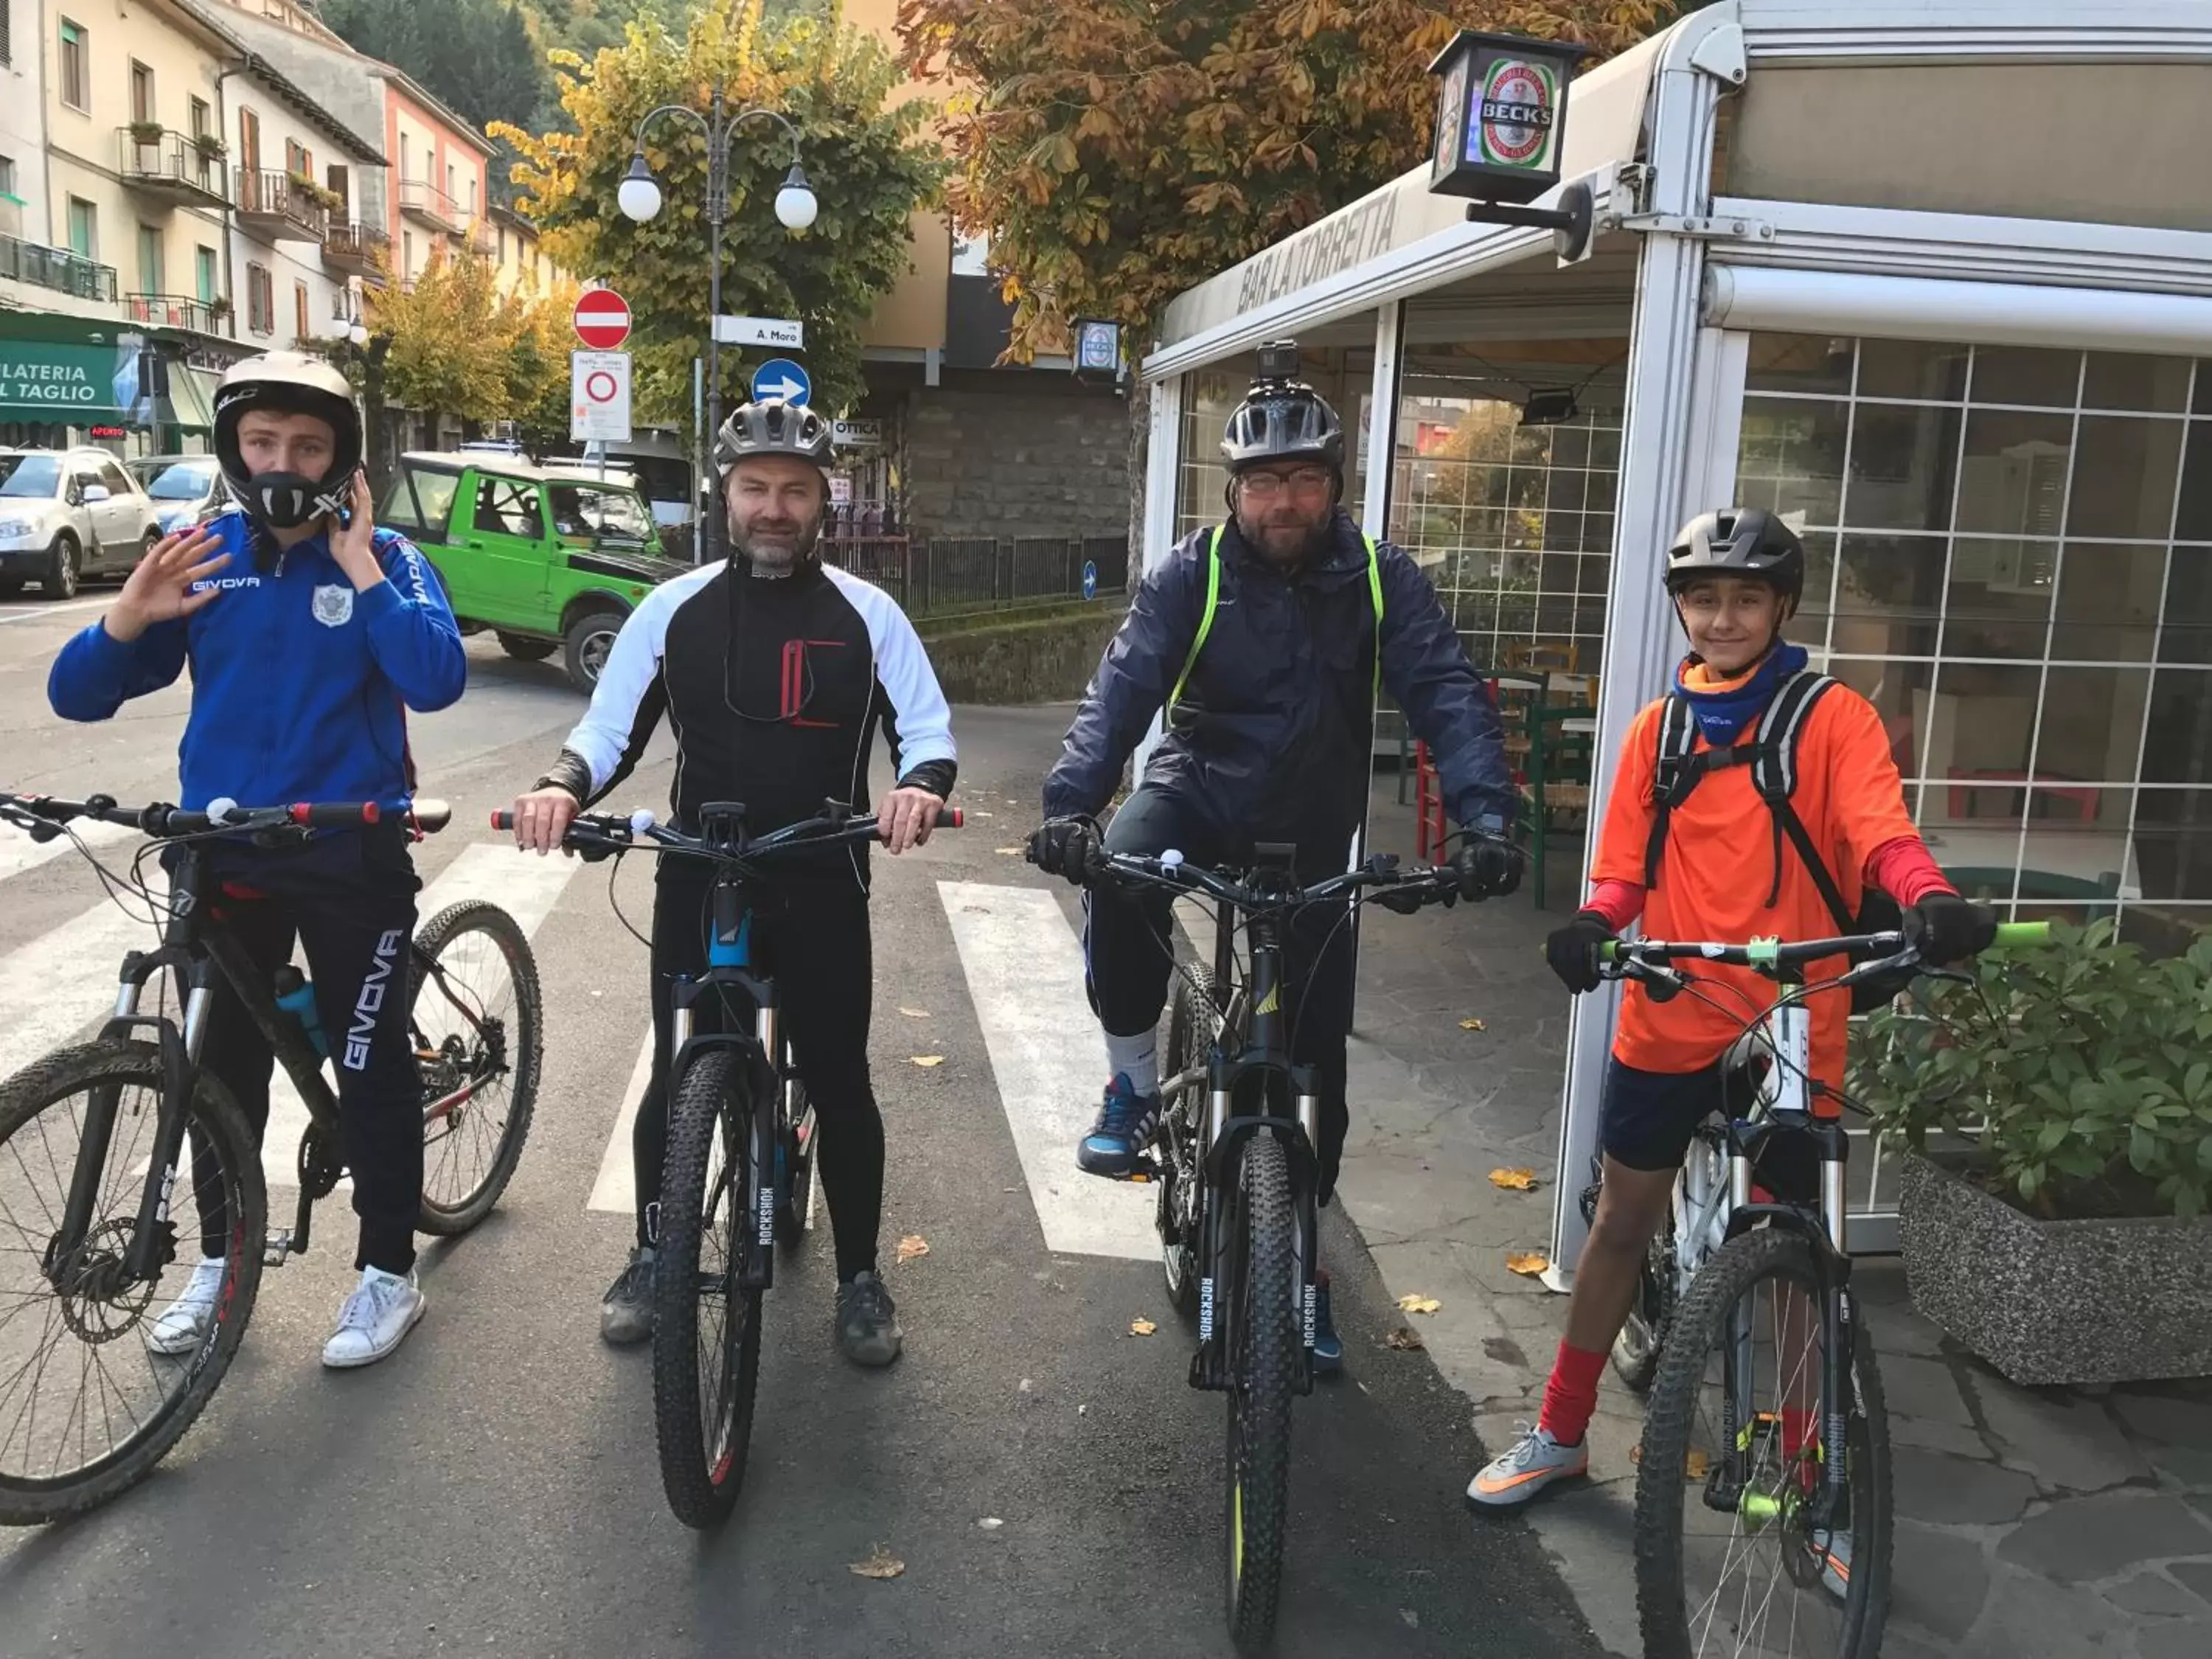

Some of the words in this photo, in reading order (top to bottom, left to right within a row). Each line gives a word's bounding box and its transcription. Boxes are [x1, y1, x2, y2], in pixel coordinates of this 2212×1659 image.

[1237, 252, 1274, 316] BAR
[1269, 241, 1296, 300] LA
[1293, 186, 1400, 292] TORRETTA
[771, 330, 797, 341] Moro
[0, 363, 86, 382] LATERIA
[18, 383, 95, 400] TAGLIO
[835, 422, 879, 435] OTTICA
[192, 577, 260, 591] GIVOVA
[343, 929, 403, 1071] GIVOVA
[759, 1188, 773, 1245] ROCKSHOX
[1200, 1277, 1213, 1340] ROCKSHOX
[1303, 1284, 1316, 1347] ROCKSHOX
